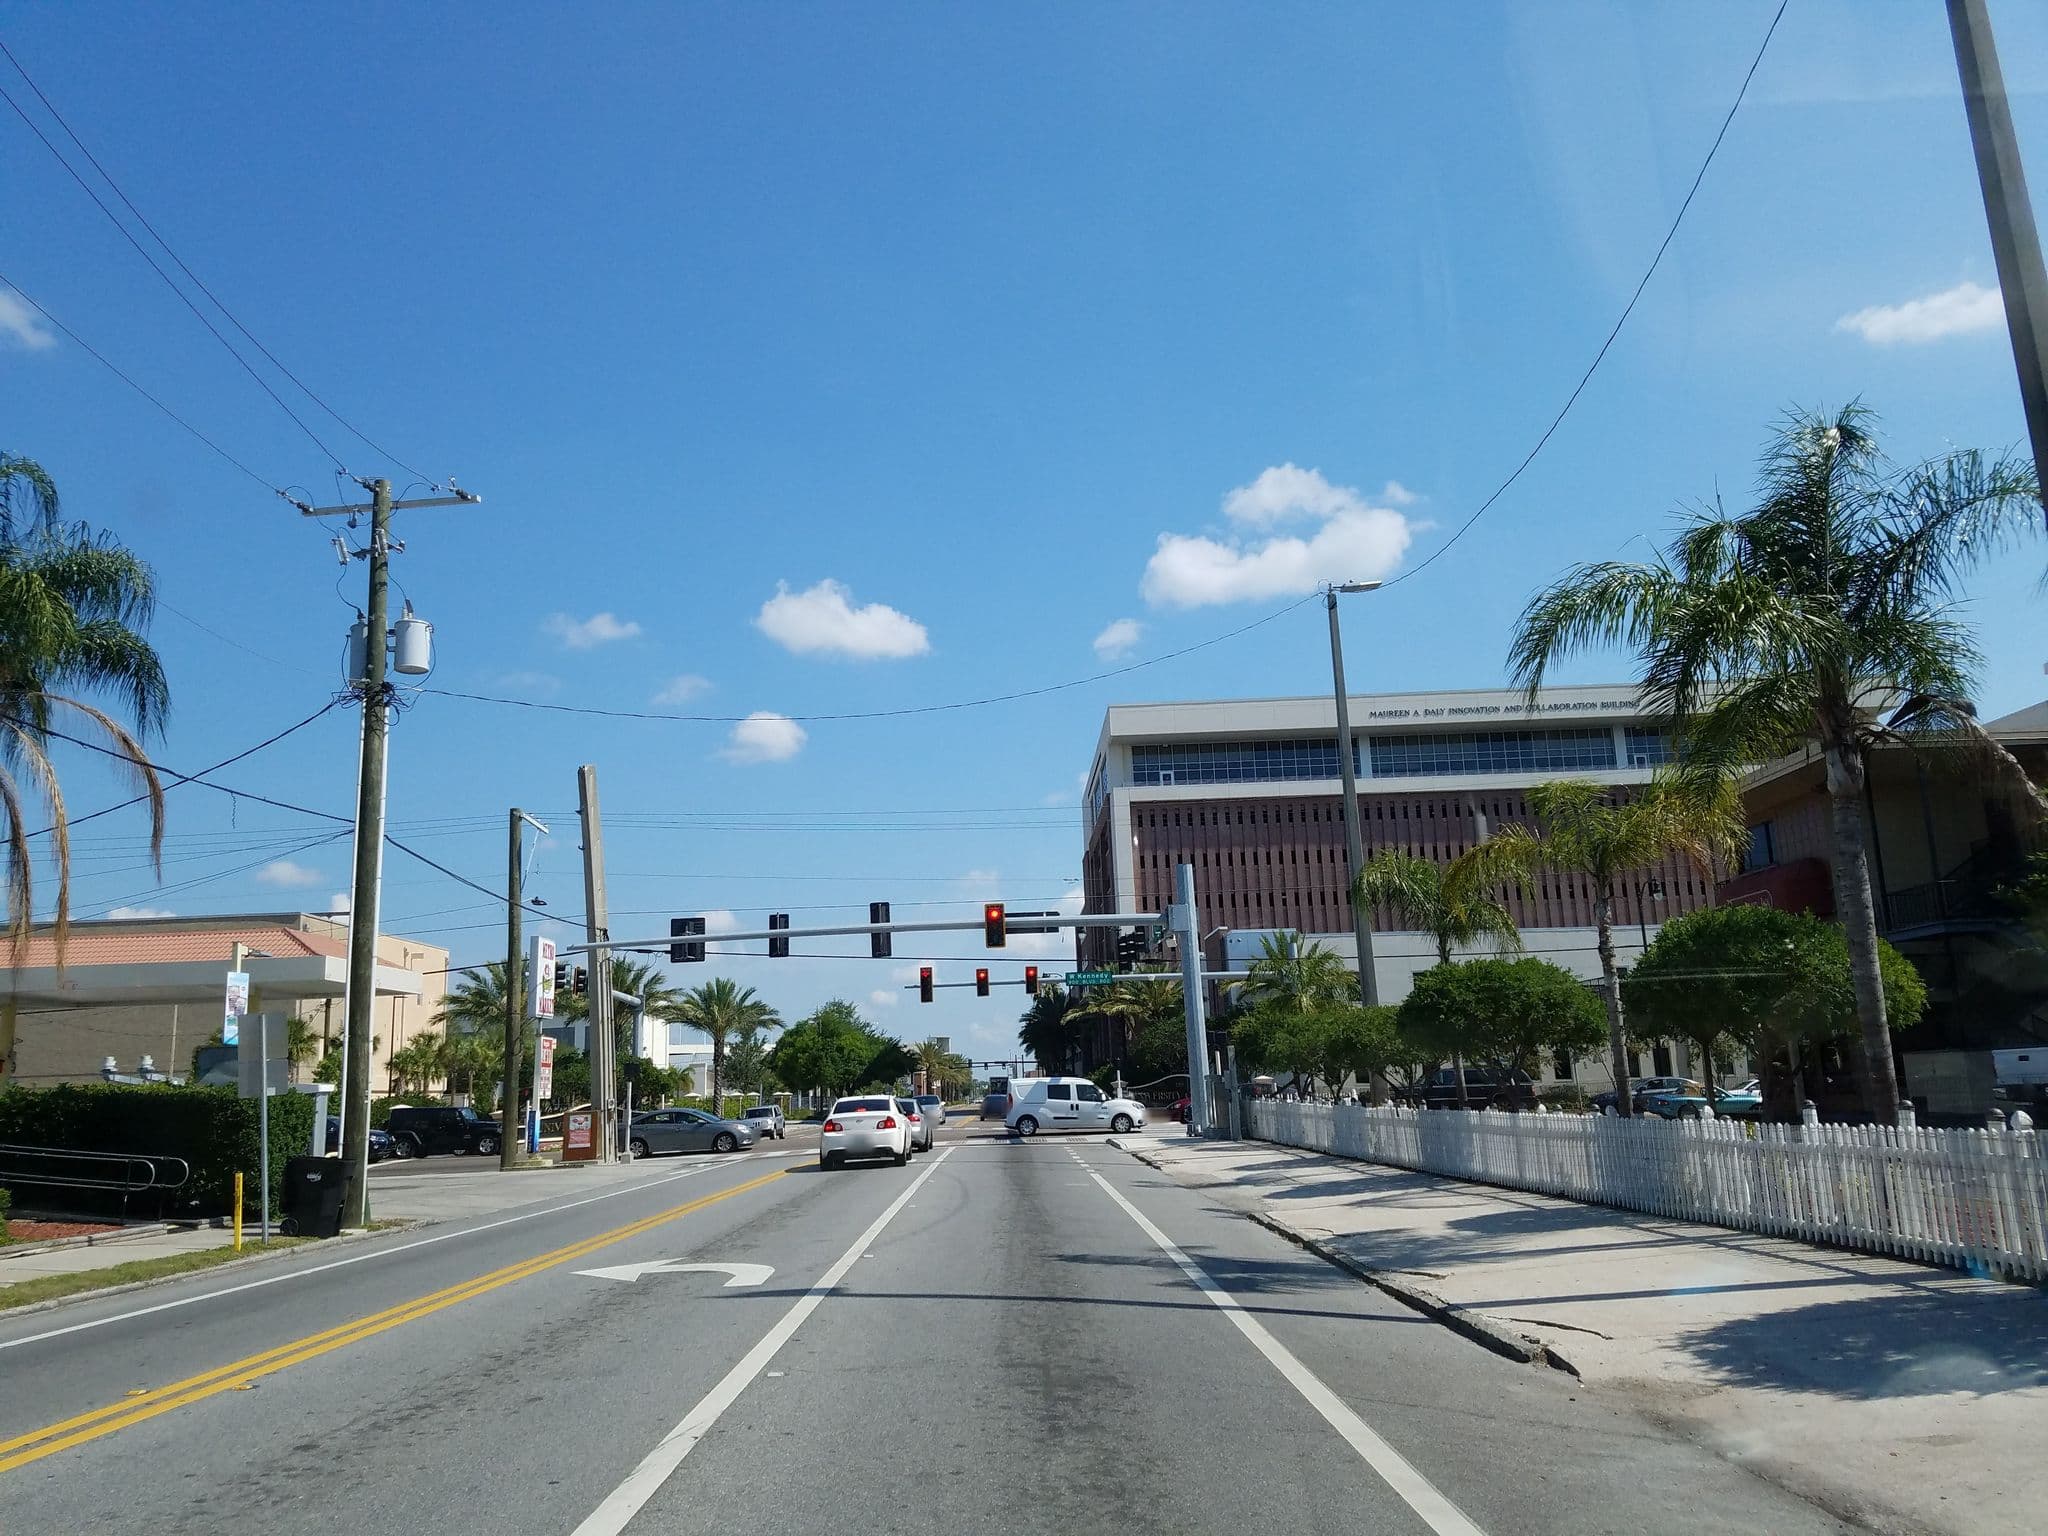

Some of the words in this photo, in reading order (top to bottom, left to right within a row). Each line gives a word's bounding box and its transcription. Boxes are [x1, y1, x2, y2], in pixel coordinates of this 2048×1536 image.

[1370, 709, 1410, 718] MAUREEN
[1424, 707, 1446, 716] DALY
[1448, 705, 1501, 716] INNOVATION
[1504, 704, 1523, 713] AND
[1525, 701, 1598, 713] COLLABORATION
[1601, 700, 1641, 710] BUILDING
[1077, 972, 1109, 980] Kennedy
